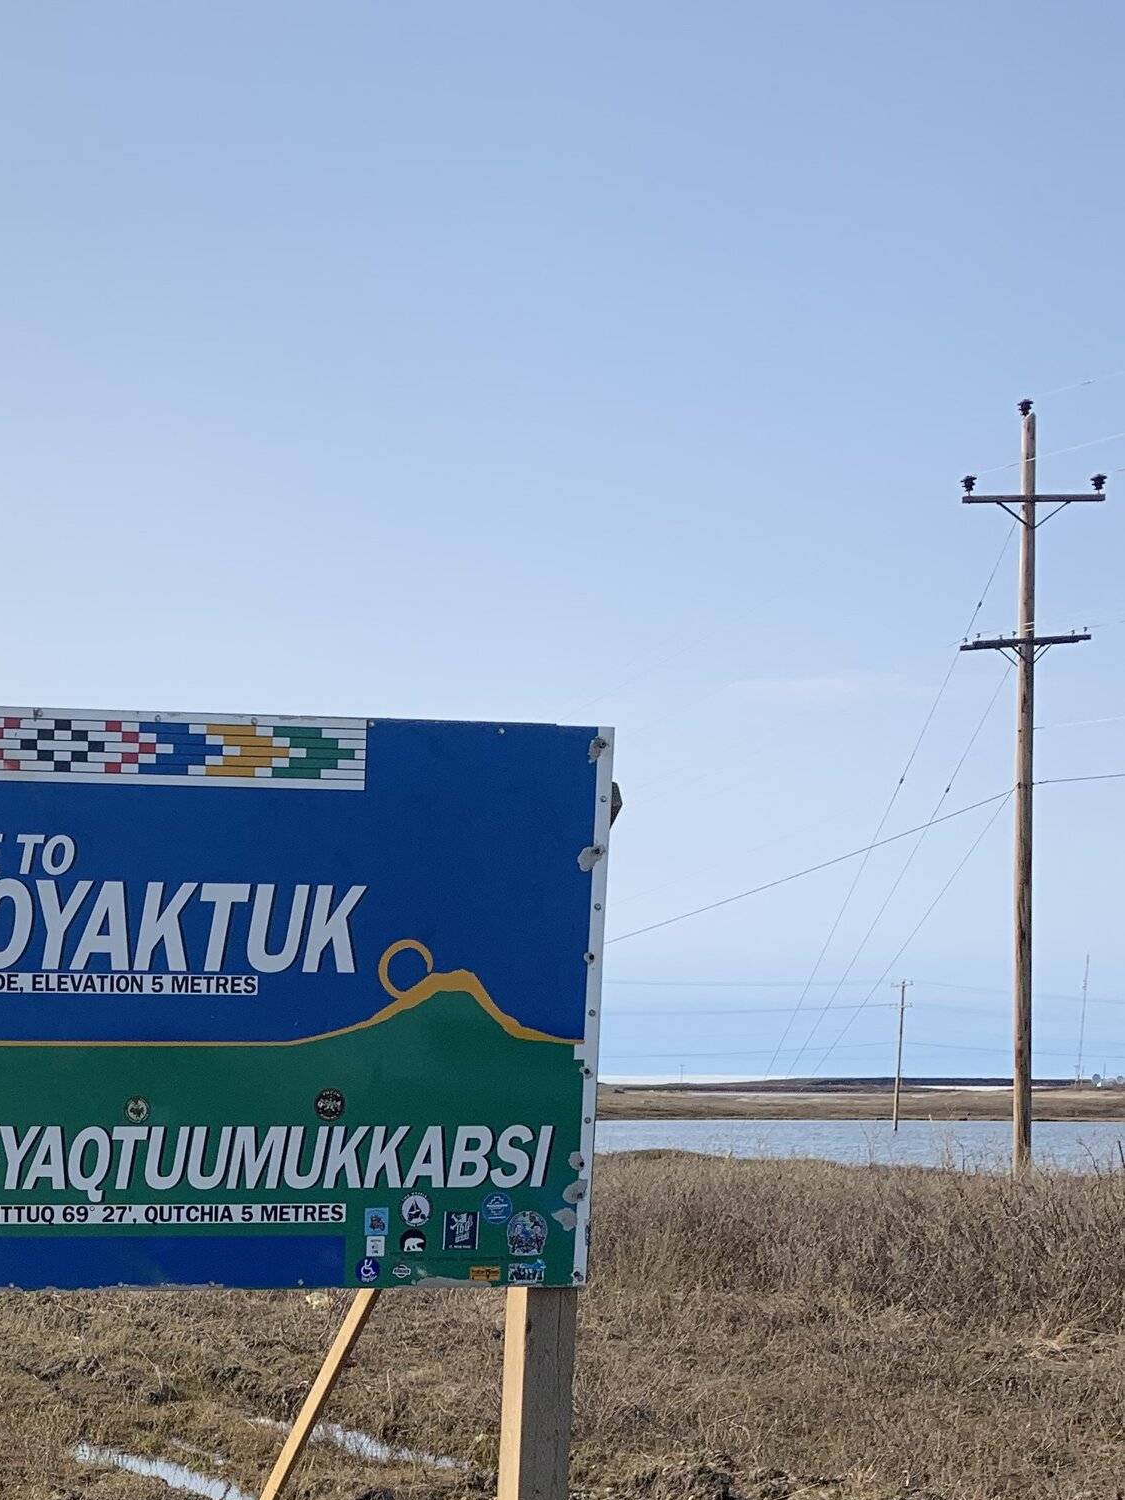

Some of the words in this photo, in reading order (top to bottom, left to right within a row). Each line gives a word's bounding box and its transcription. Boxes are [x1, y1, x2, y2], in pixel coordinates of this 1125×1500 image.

[16, 833, 75, 876] TO
[32, 974, 143, 993] ELEVATION
[151, 975, 164, 994] 5
[171, 975, 256, 994] METRES
[144, 1205, 233, 1225] QUTCHIA
[241, 1205, 253, 1222] 5
[260, 1204, 343, 1222] METRES
